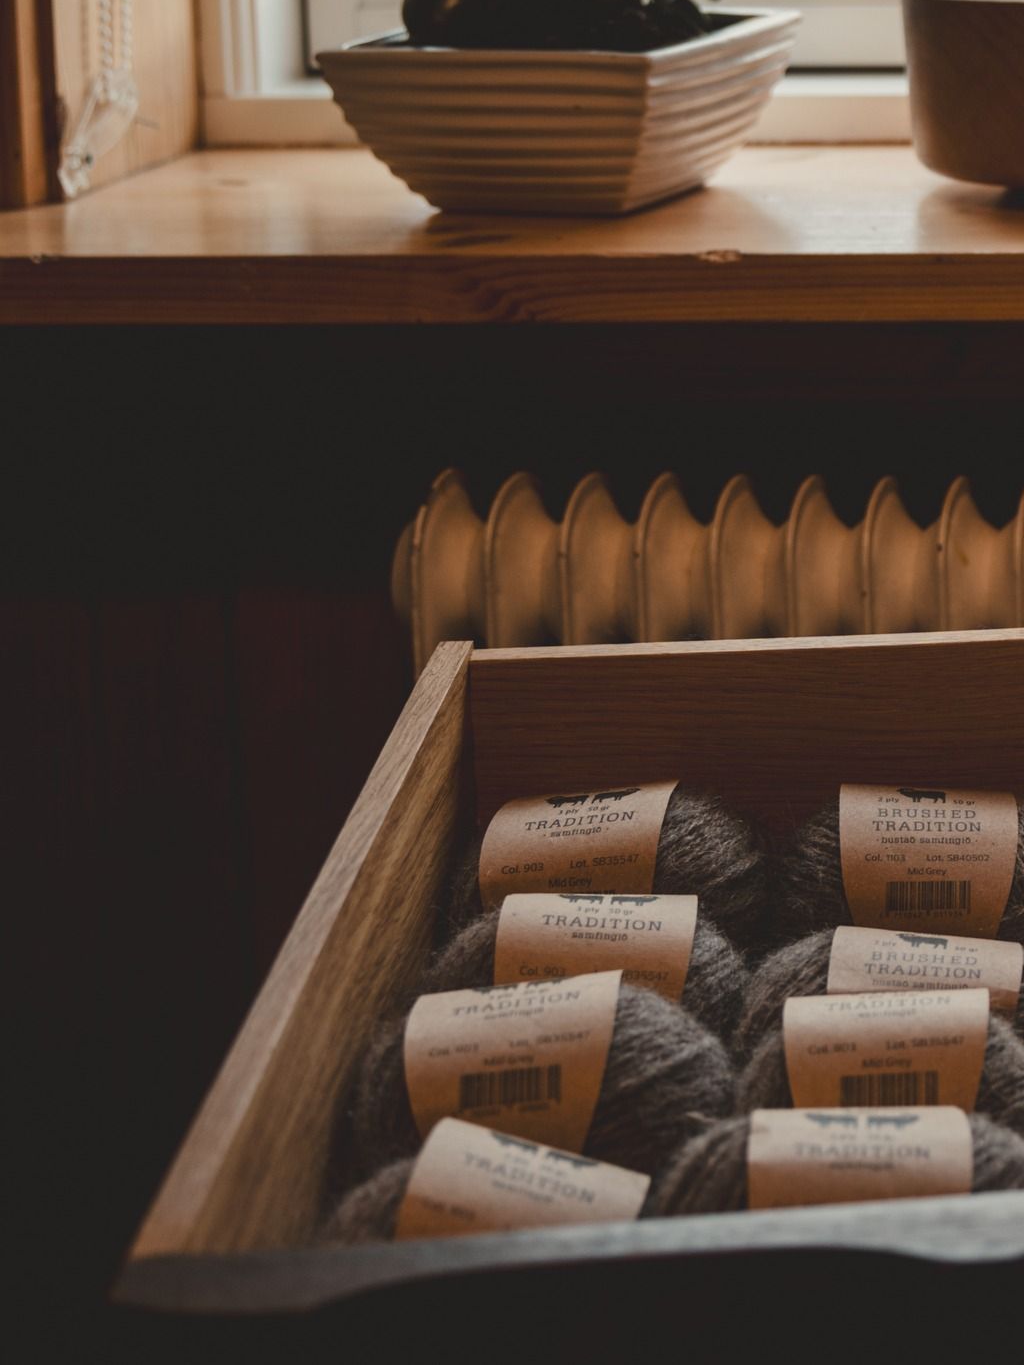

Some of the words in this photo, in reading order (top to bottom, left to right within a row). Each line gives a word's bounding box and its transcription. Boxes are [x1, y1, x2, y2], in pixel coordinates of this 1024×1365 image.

[885, 796, 900, 805] ply
[565, 808, 579, 816] ply
[878, 807, 977, 819] BRUSHED
[524, 810, 635, 831] TRADITION
[872, 820, 982, 833] TRADITION
[523, 862, 544, 873] 903
[592, 854, 639, 867] SB35547
[886, 854, 906, 862] 1103
[946, 854, 990, 862] SB40502
[907, 867, 924, 875] Mid
[925, 867, 948, 877] Grey
[547, 877, 567, 889] Mid
[569, 876, 593, 890] Grey
[541, 914, 663, 931] TRADITION
[871, 951, 979, 966] BRUSHED
[864, 963, 981, 980] TRADITION
[453, 990, 581, 1016] TRADITION
[825, 995, 951, 1012] TRADITION
[795, 1141, 931, 1160] TRADITION
[465, 1152, 596, 1205] TRADITION
